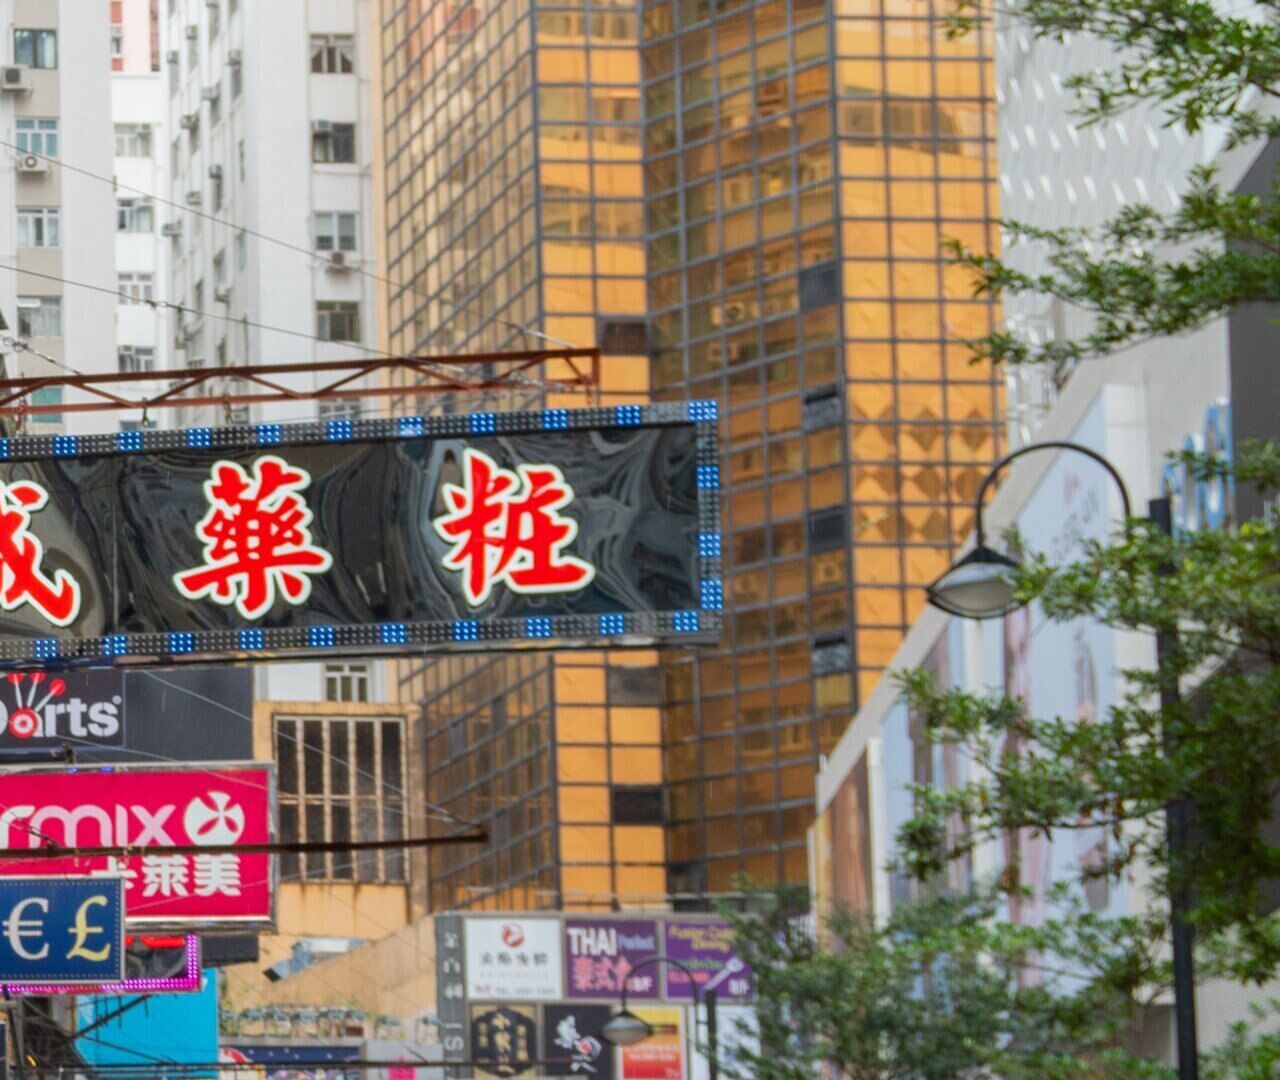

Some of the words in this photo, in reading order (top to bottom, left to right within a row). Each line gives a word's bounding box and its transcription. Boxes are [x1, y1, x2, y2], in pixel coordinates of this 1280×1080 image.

[90, 854, 242, 899] 卡萊美
[567, 927, 617, 956] THAI
